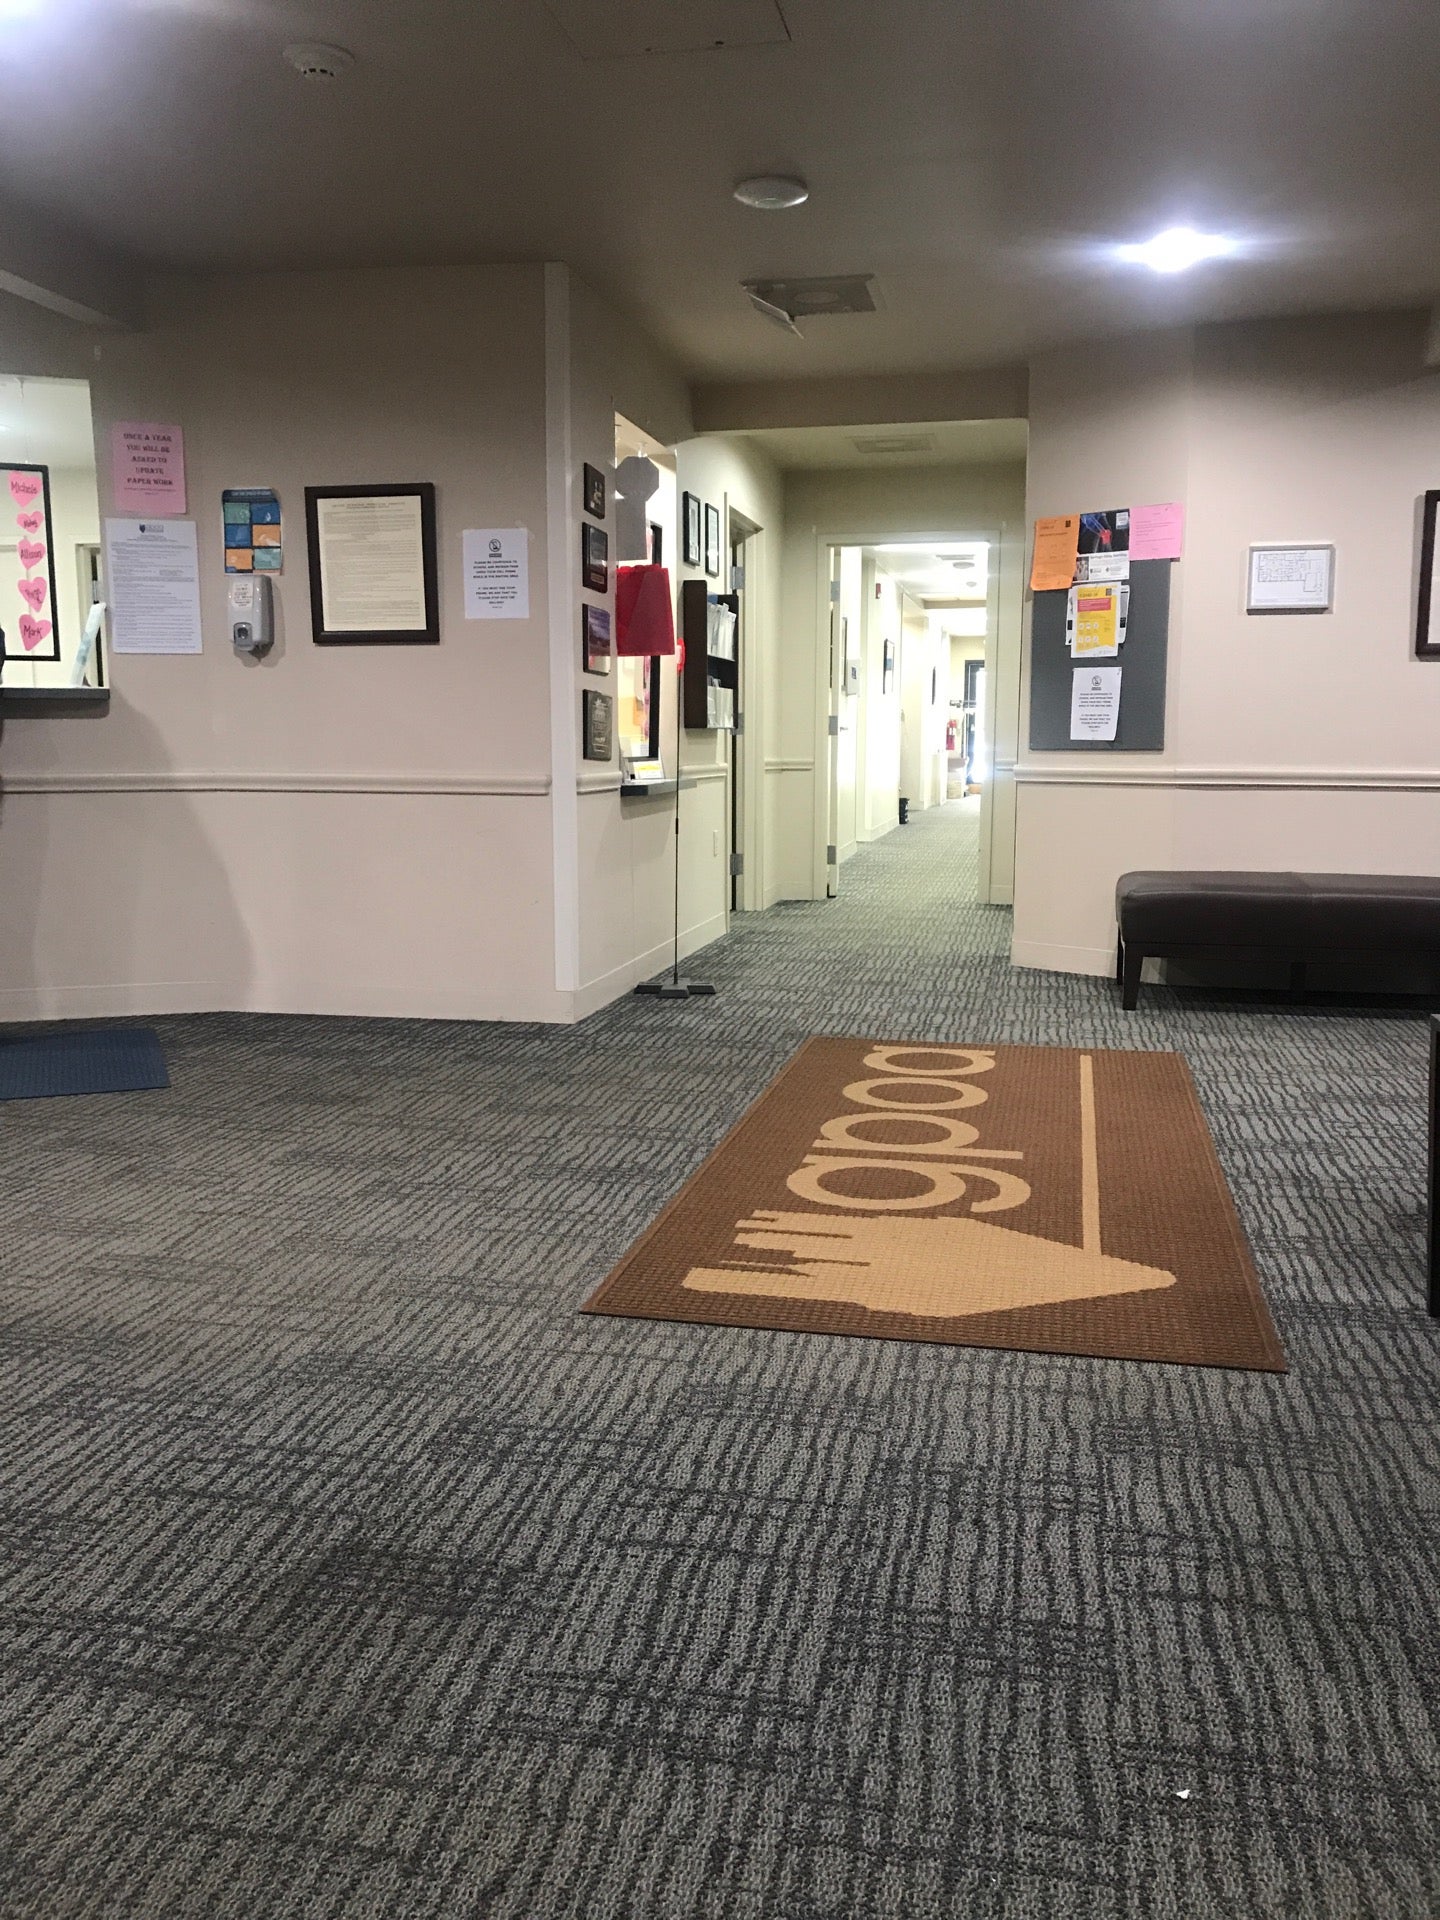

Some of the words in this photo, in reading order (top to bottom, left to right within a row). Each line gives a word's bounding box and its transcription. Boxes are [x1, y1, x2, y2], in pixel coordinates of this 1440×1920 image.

[152, 434, 172, 442] YEAR
[23, 624, 43, 640] Mark
[786, 1045, 1031, 1213] gpoa
